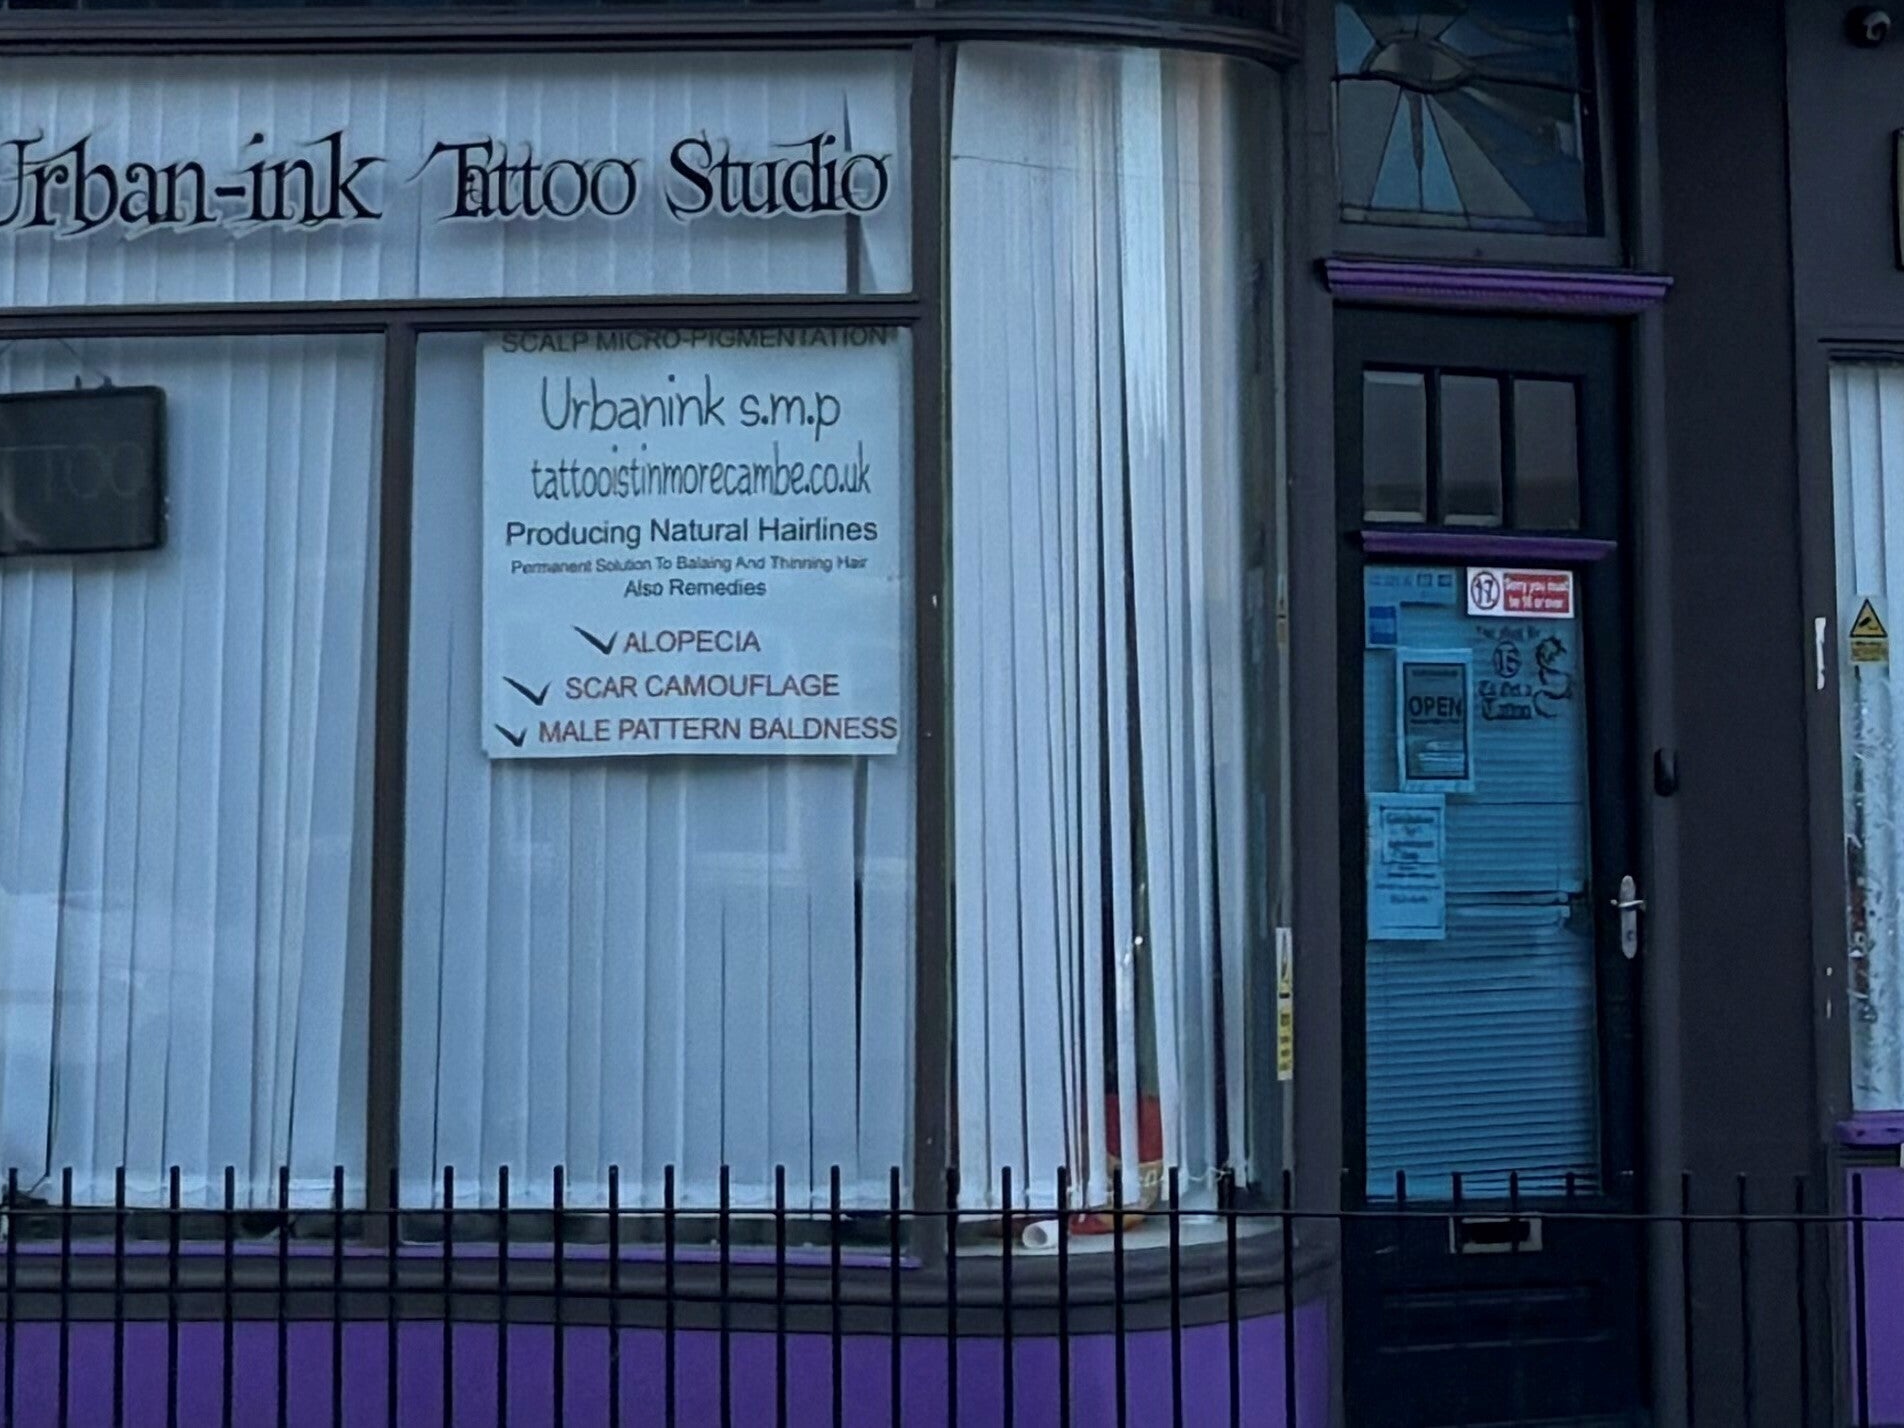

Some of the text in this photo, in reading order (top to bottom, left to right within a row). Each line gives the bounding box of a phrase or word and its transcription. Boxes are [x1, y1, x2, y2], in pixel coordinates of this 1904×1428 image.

[407, 138, 639, 224] Tattoo
[665, 129, 890, 222] Studio
[501, 327, 887, 354] SCALP MICRO-PIGMENTATION
[541, 374, 841, 441] Urbanink s.m.p
[531, 442, 871, 501] tattooistinmorecambe.co.uk
[505, 517, 878, 549] Producing Natural Hairlines
[511, 559, 592, 574] Permanent
[656, 557, 673, 570] To
[736, 556, 765, 570] And
[624, 579, 766, 597] Also Remedies
[623, 631, 760, 653] ALOPECIA
[565, 674, 839, 699] SCAR CAMOUFLAGE
[1409, 696, 1462, 717] OPEN
[539, 716, 898, 742] MALE PATTERN BALDNESS
